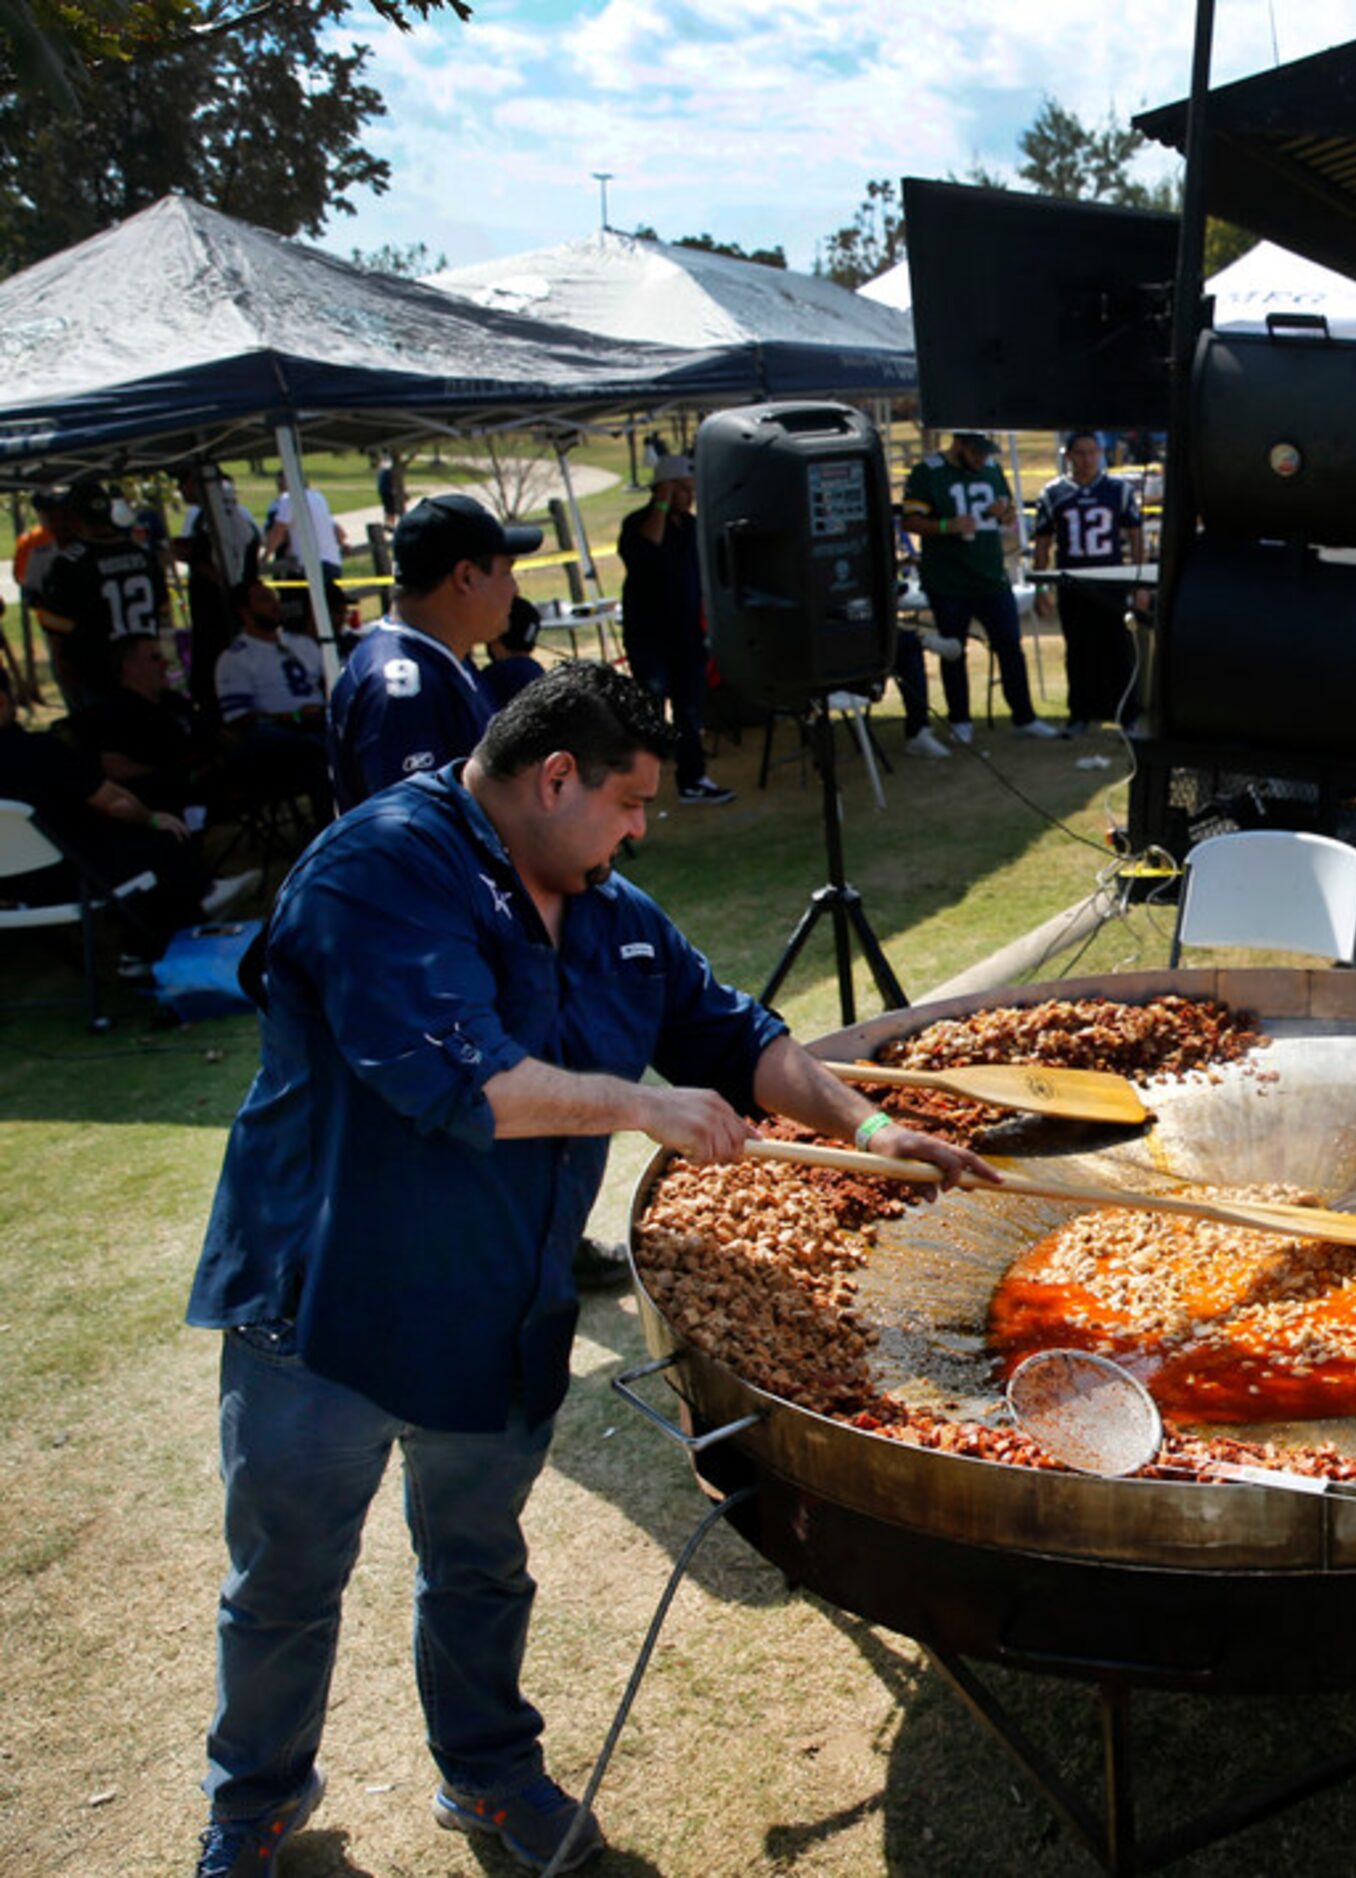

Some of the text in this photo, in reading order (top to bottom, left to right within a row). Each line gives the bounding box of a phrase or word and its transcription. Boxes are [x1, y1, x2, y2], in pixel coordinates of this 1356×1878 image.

[949, 482, 998, 530] 12
[1064, 506, 1113, 556] 12
[102, 576, 156, 640] 12
[384, 659, 421, 697] 9
